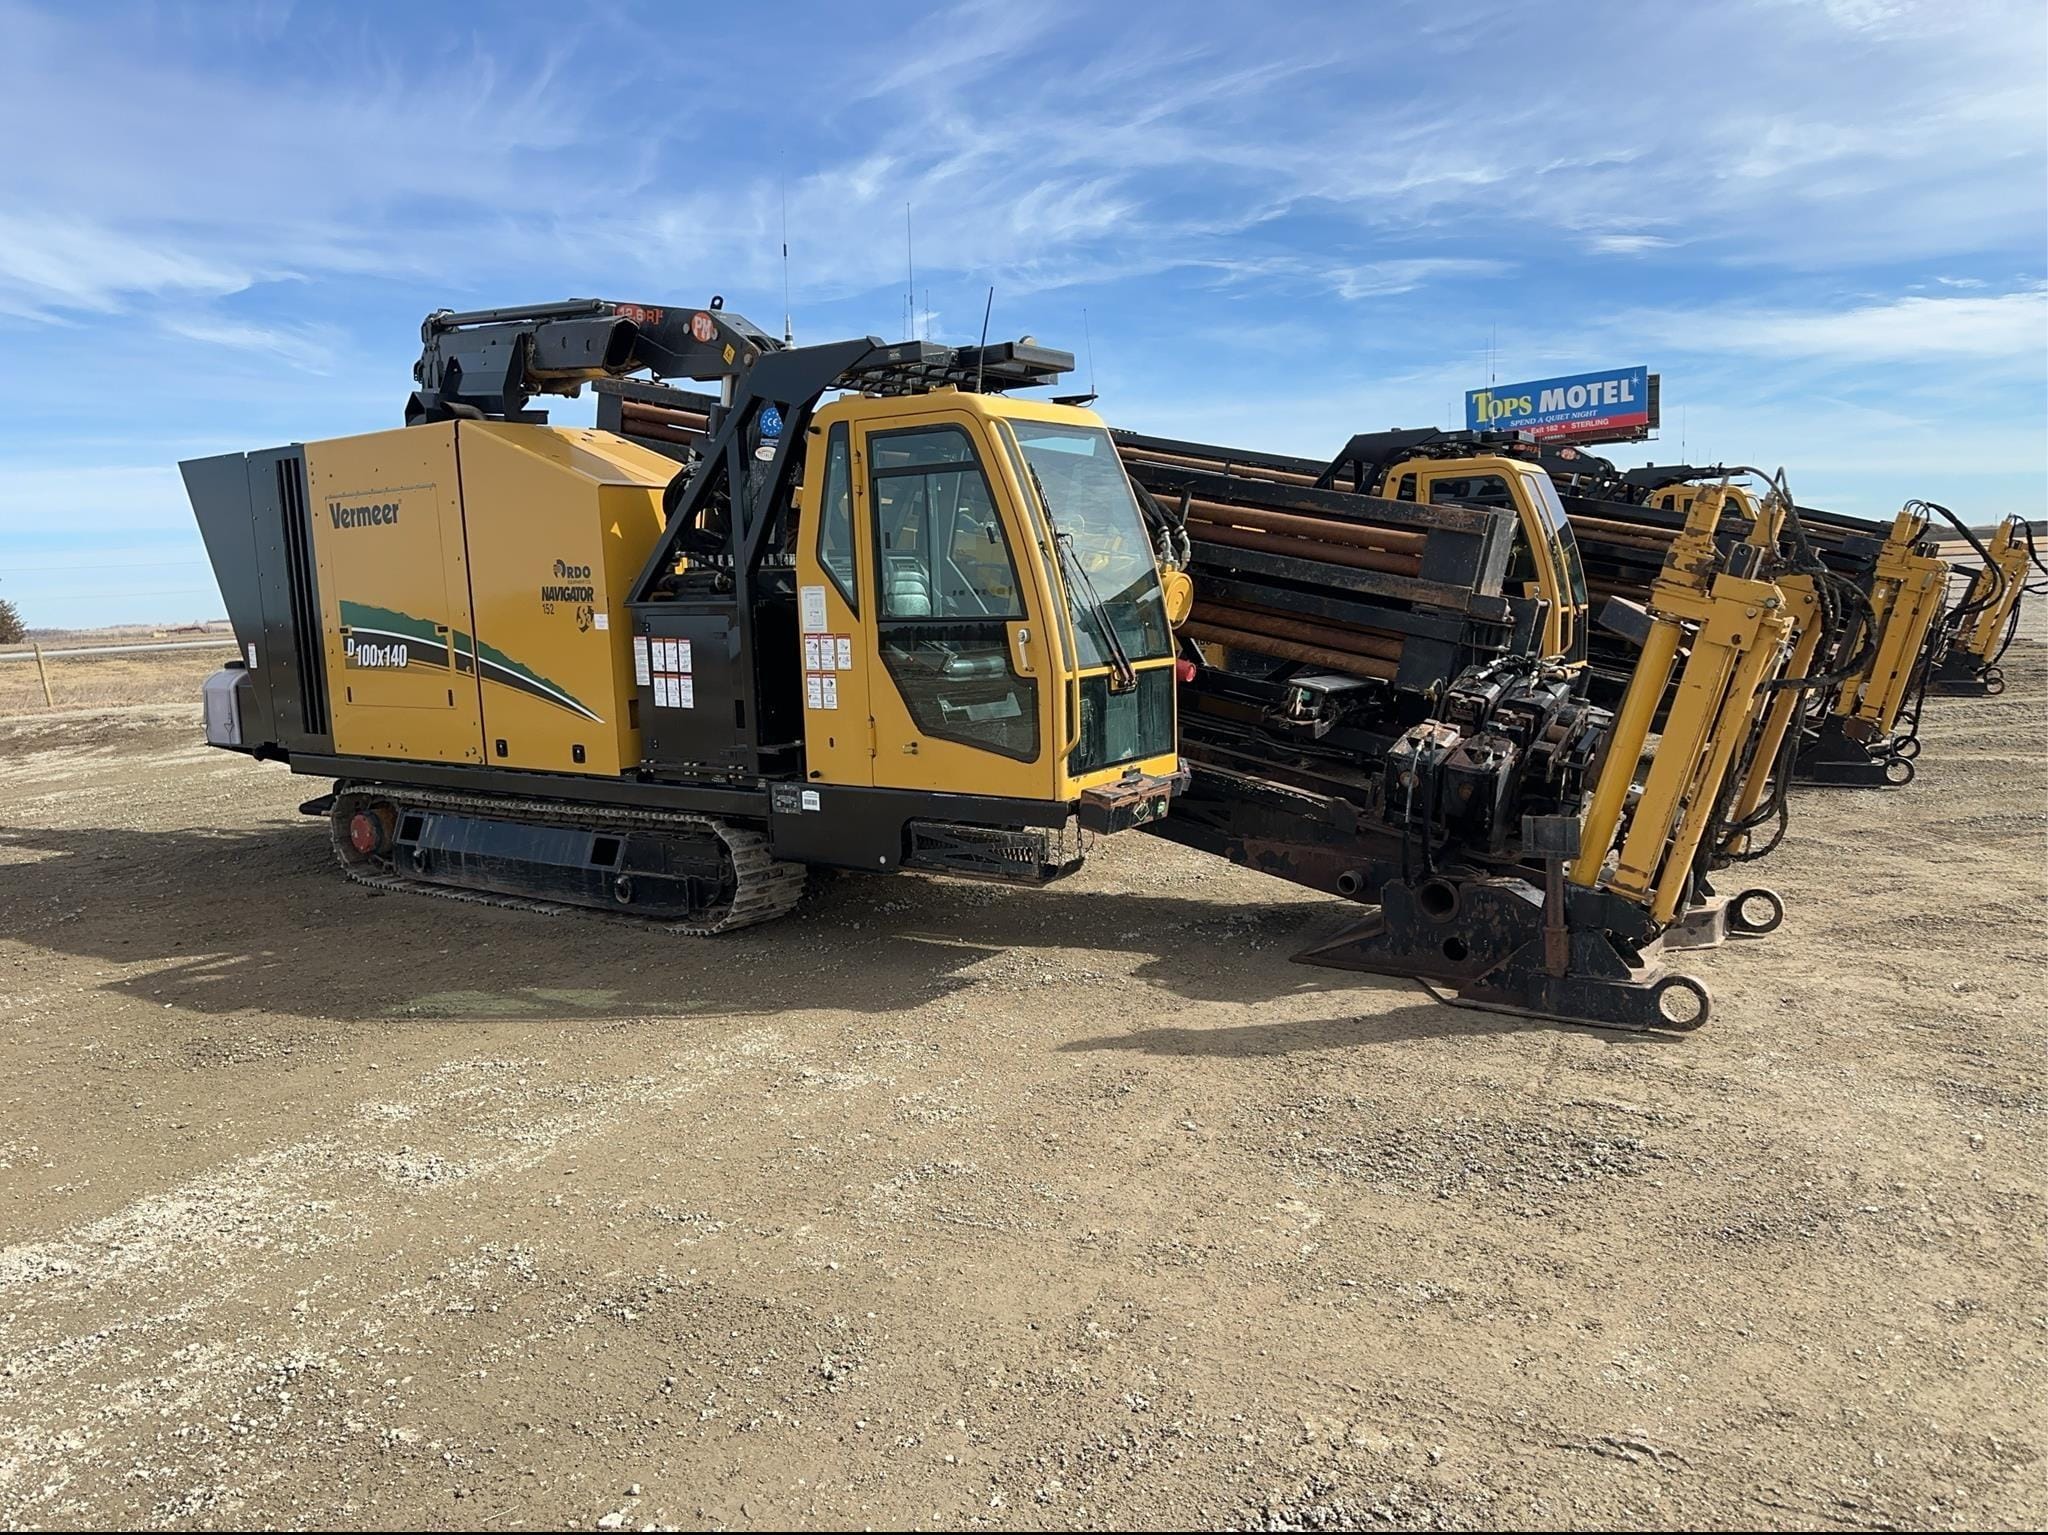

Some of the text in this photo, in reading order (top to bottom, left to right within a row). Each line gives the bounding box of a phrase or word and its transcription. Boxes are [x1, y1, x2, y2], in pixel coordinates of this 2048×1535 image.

[1538, 378, 1634, 413] MOTEL
[1510, 417, 1537, 427] SPEND
[1545, 413, 1570, 422] QUIET
[1571, 409, 1598, 418] NIGHT
[1530, 426, 1544, 434] Exit
[1570, 418, 1609, 429] STERLING
[329, 502, 399, 529] Vermeer
[541, 586, 594, 602] NAVIGATOR
[542, 603, 555, 615] 152
